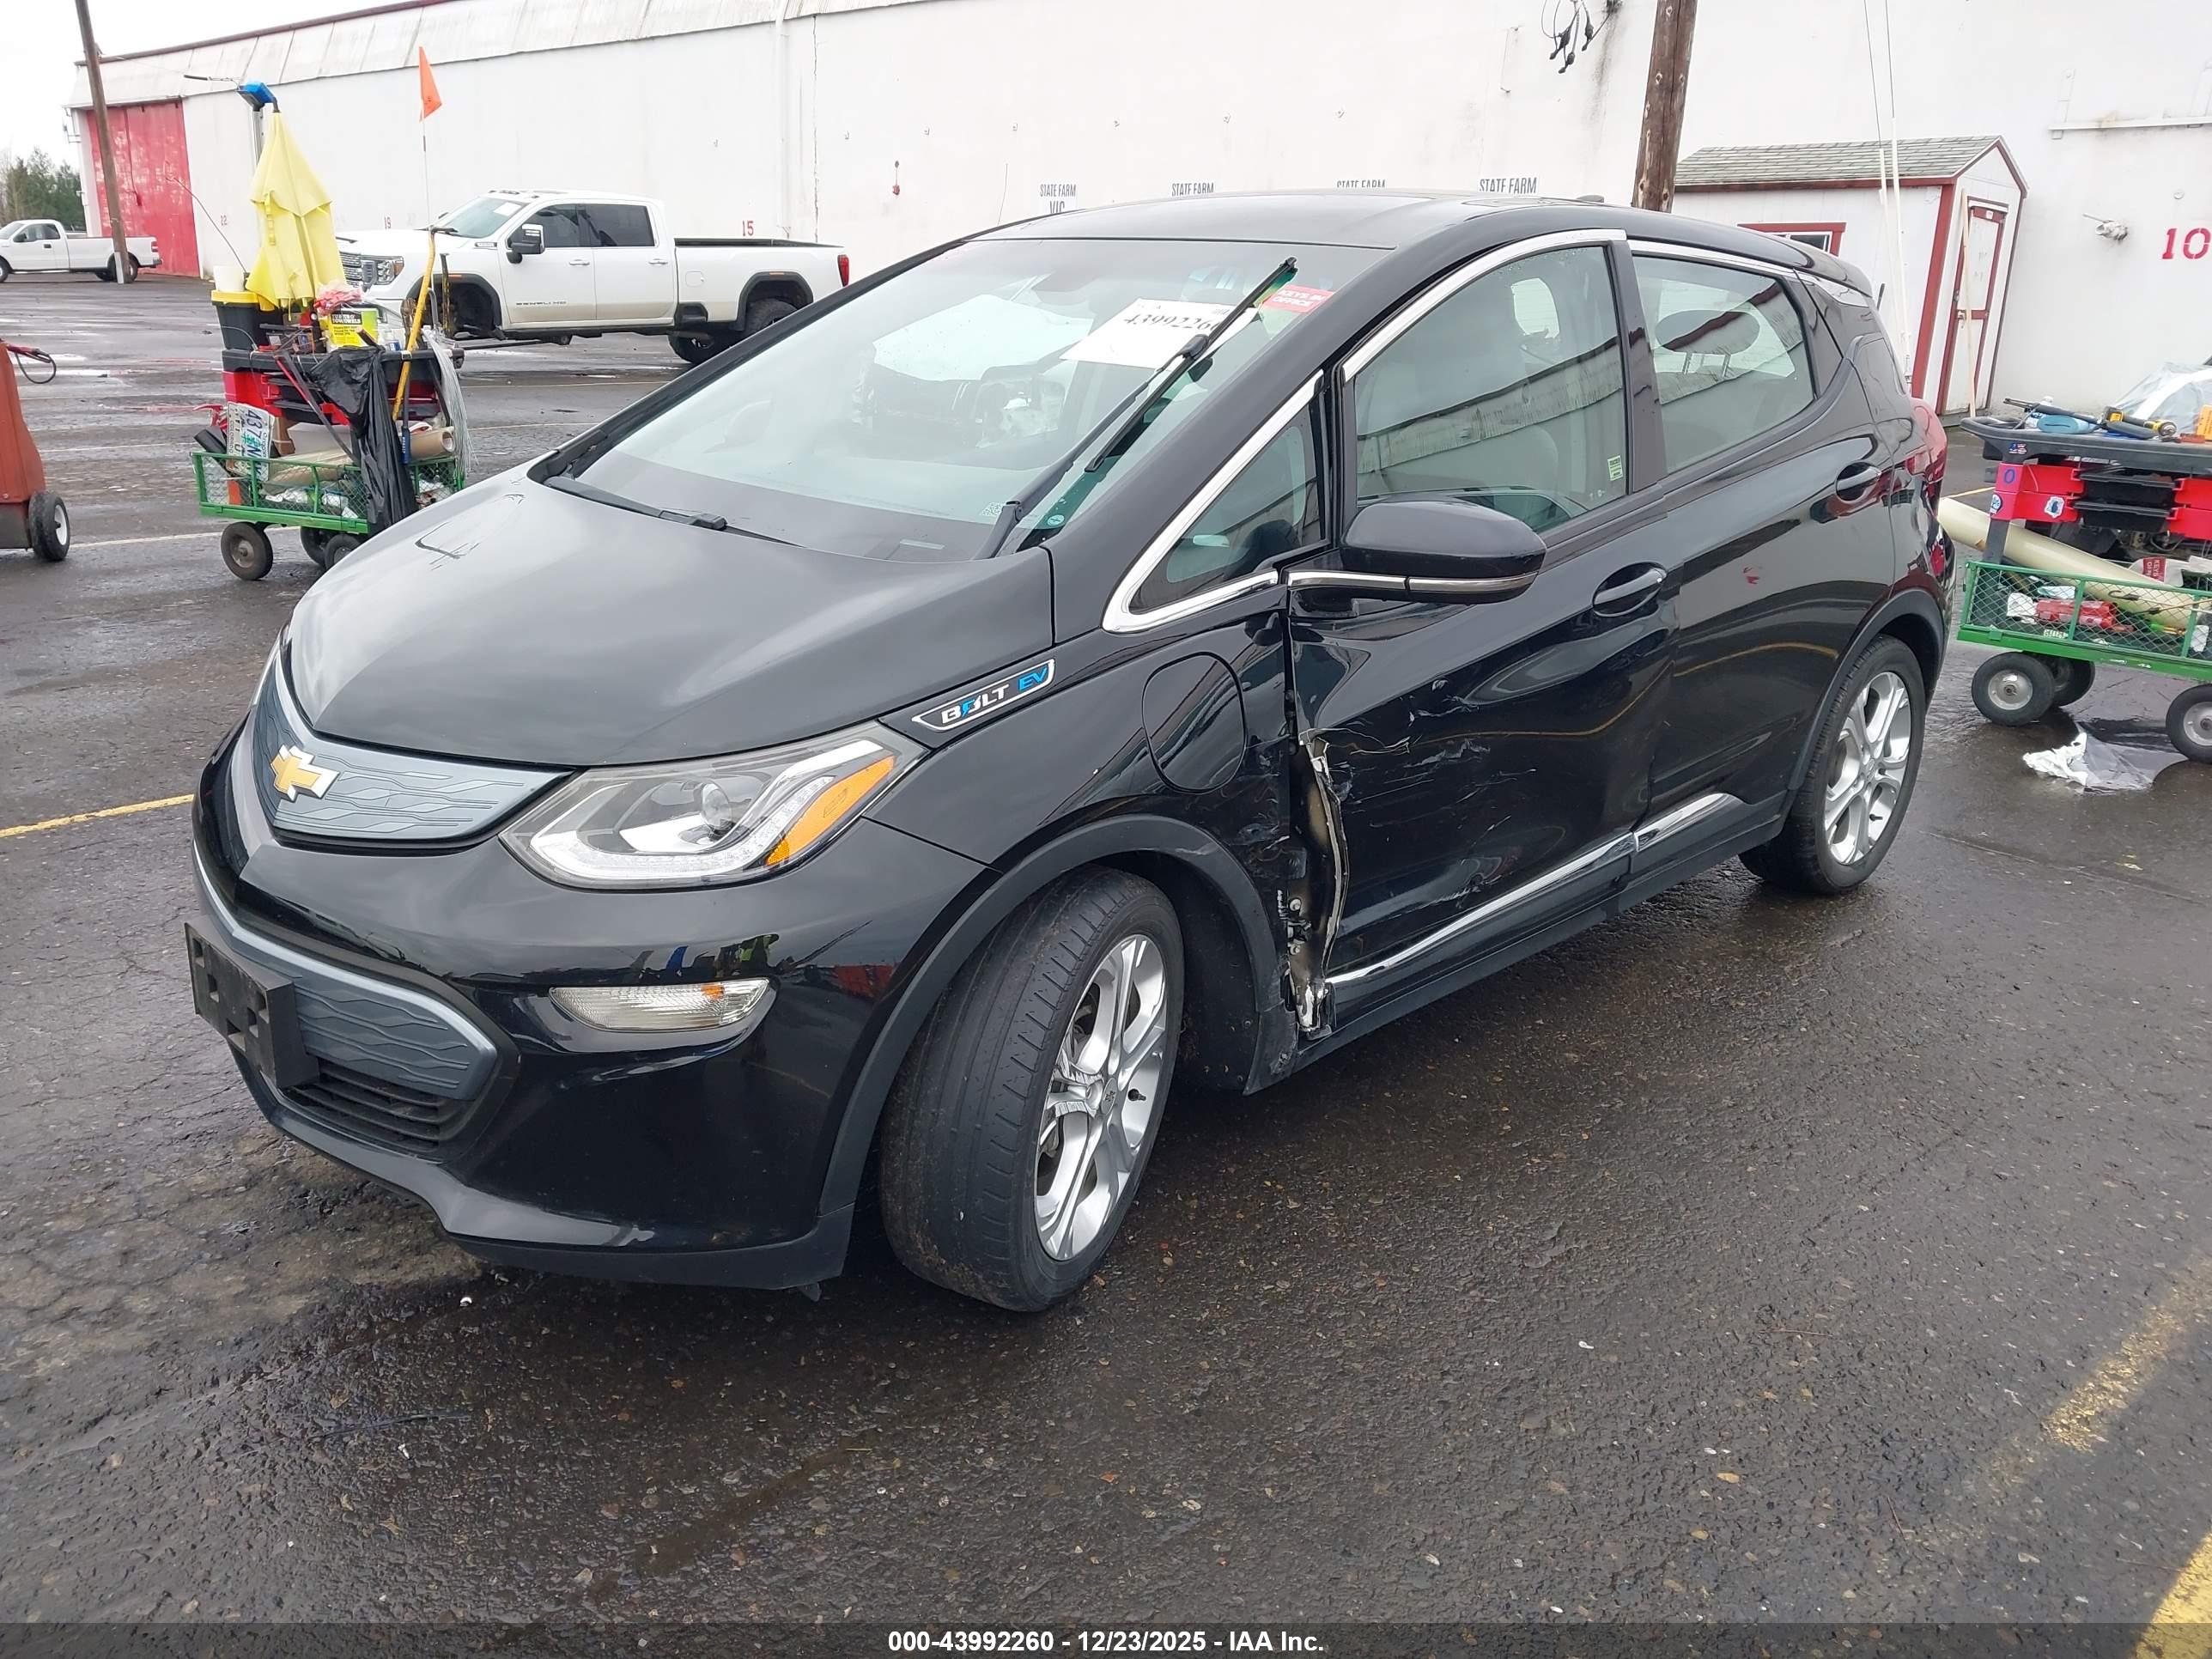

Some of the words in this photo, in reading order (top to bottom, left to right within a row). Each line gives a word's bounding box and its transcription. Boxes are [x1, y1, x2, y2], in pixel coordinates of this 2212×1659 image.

[1040, 183, 1058, 198] STATE
[1058, 183, 1077, 197] FARM
[1171, 182, 1192, 197] STATE
[1193, 181, 1214, 195] FARM
[1480, 178, 1507, 192] STATE
[1508, 176, 1537, 194] FARM
[742, 220, 754, 237] 15
[2161, 228, 2211, 260] 10
[1272, 296, 1316, 308] OFFICE
[1280, 289, 1311, 299] KEYS
[246, 410, 263, 439] 437
[940, 684, 1010, 724] BOLT
[1018, 666, 1048, 690] EV
